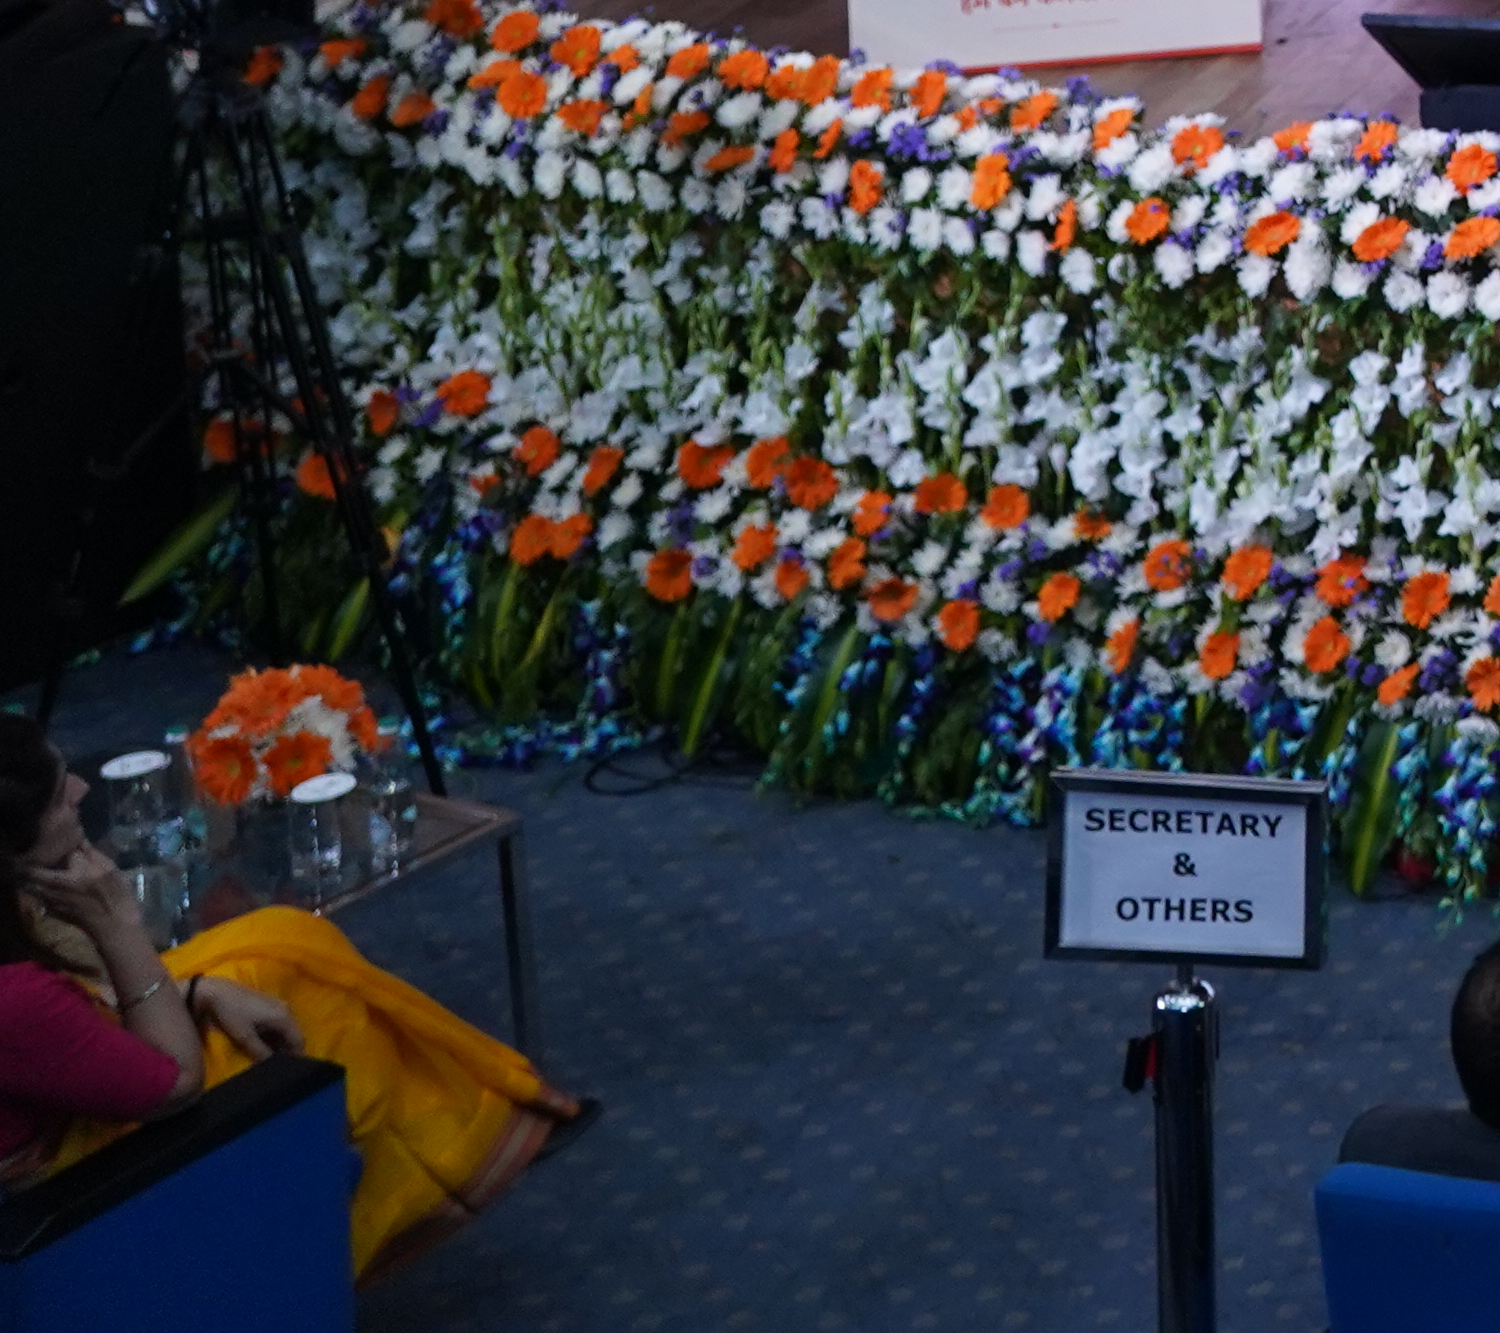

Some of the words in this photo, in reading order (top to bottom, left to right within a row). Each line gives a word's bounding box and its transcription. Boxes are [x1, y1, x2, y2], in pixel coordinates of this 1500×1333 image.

[1084, 807, 1284, 838] SECRETARY
[1172, 851, 1198, 878] &
[1115, 896, 1255, 923] OTHERS
